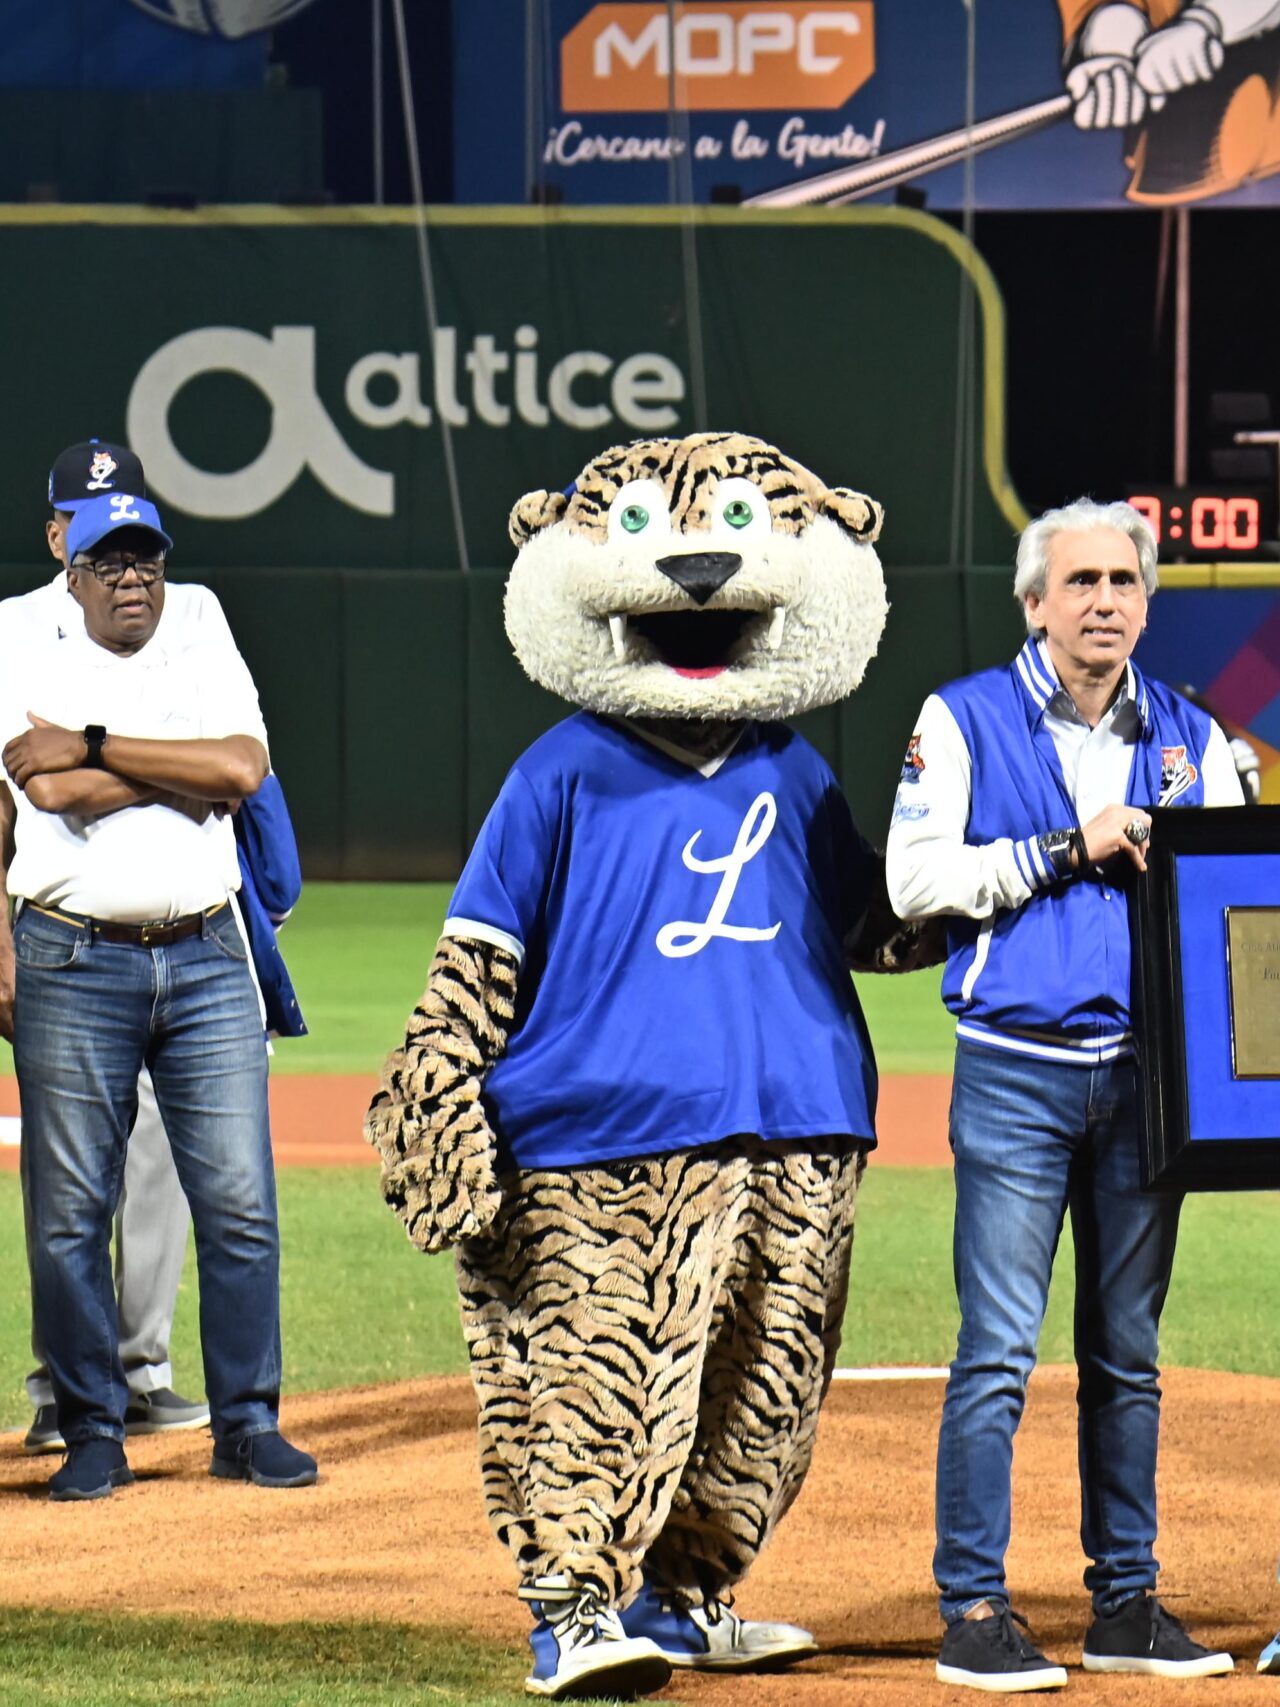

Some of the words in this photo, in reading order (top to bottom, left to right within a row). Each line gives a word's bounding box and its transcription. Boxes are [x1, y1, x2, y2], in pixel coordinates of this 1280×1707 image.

[593, 12, 861, 78] MOPC
[694, 135, 722, 160] a
[730, 119, 769, 161] la
[777, 117, 886, 168] Gente!
[345, 325, 686, 431] altice
[109, 494, 141, 521] L
[655, 791, 782, 959] L
